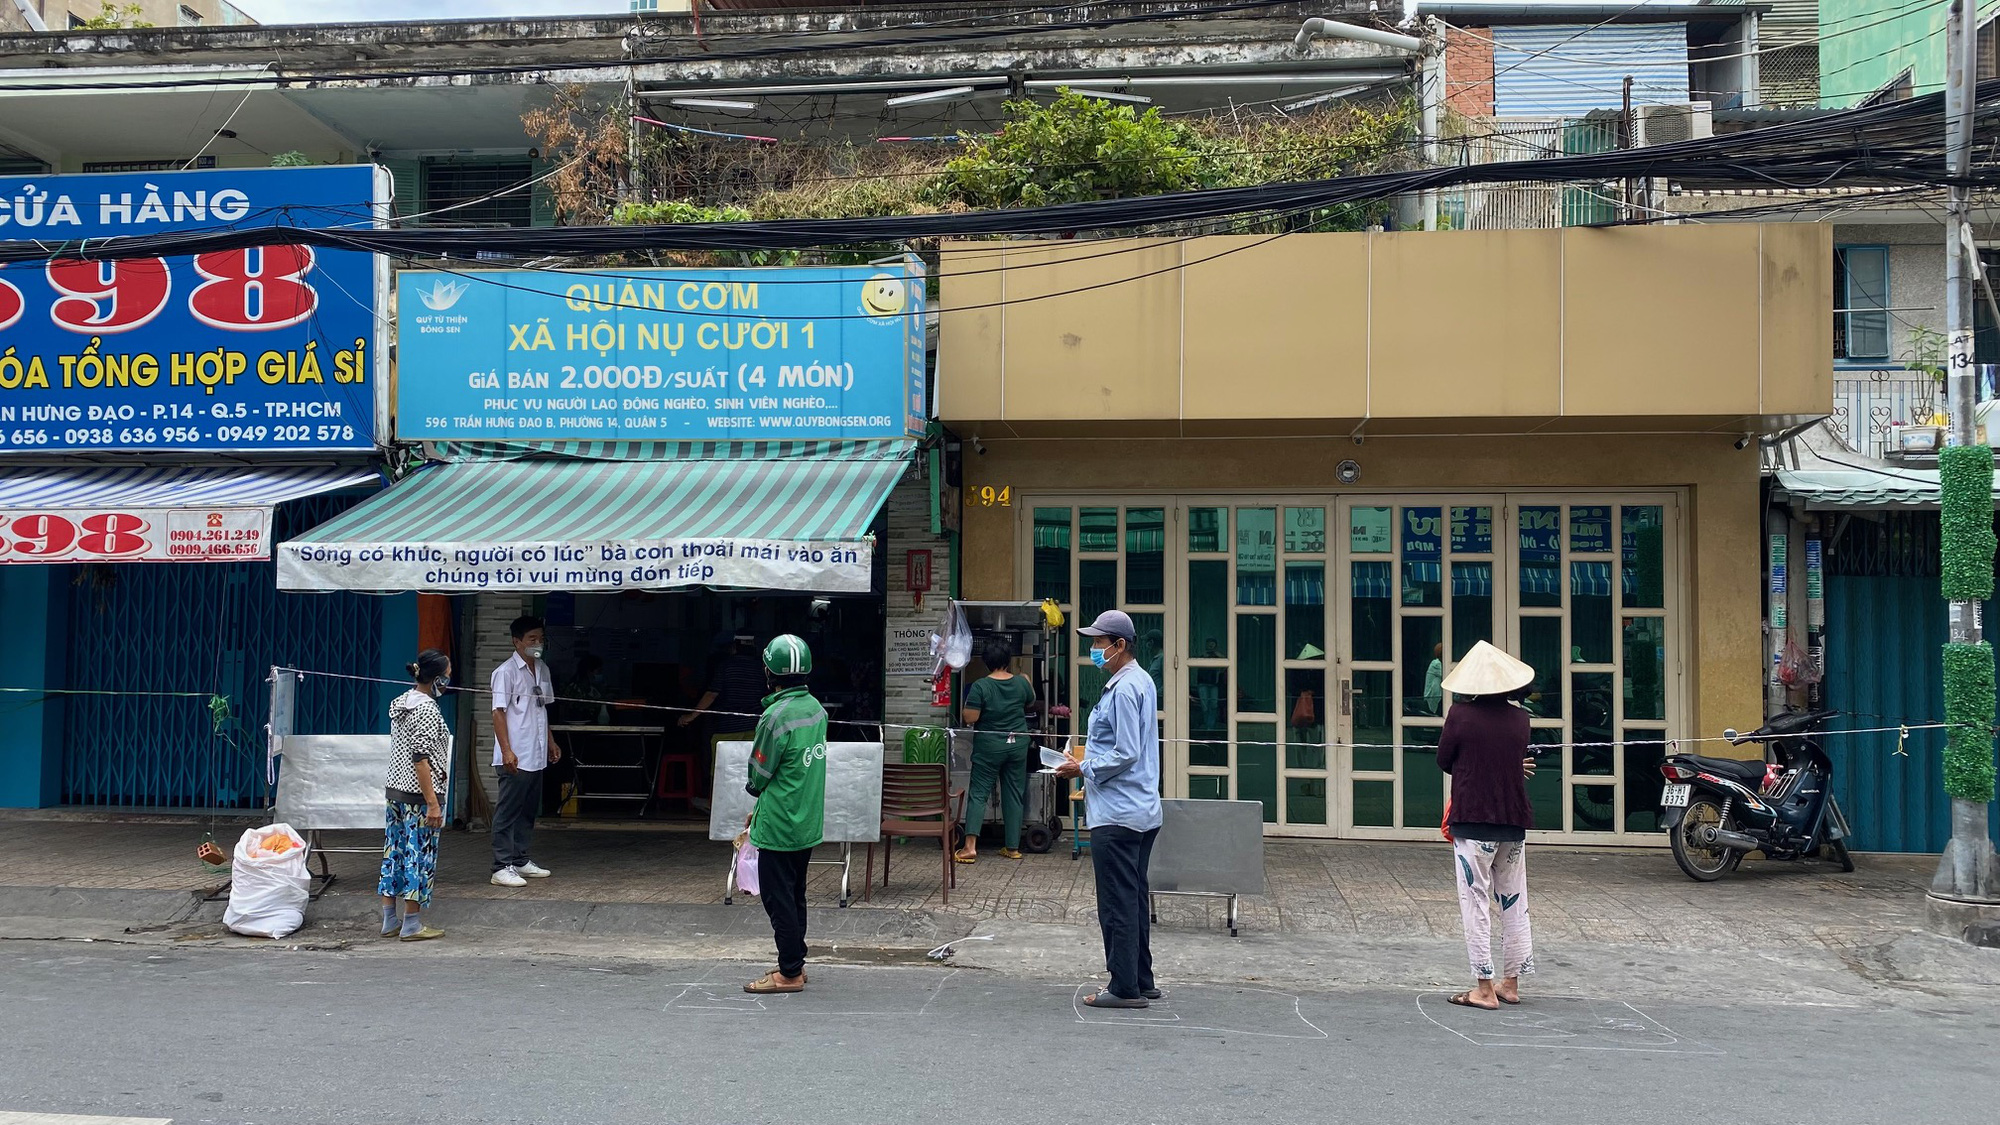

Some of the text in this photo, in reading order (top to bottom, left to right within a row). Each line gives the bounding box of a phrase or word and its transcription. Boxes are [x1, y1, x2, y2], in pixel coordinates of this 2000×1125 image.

[100, 183, 250, 224] HÀNG
[0, 243, 319, 336] 98
[565, 278, 758, 313] QUÁN CƠM
[421, 324, 444, 333] BÔNG
[508, 315, 815, 357] XÃ HỘI NỤ CƯỜI 1
[57, 336, 160, 388] TỔNG
[170, 346, 247, 395] HỢP
[257, 339, 324, 386] GIÁ
[334, 337, 366, 385] SỈ
[508, 369, 549, 389] BÁN
[560, 365, 729, 389] 2.000Đ/SUẤT
[738, 362, 766, 392] (4
[777, 360, 854, 392] MÓN)
[0, 406, 15, 421] N
[22, 404, 82, 421] HƯNG
[87, 404, 135, 425] ĐẠO
[153, 403, 193, 420] P.14
[211, 402, 247, 419] Q.5
[265, 402, 341, 418] TP.HCM
[484, 398, 518, 413] PHỤC
[523, 398, 542, 413] VỤ
[547, 396, 586, 410] NGƯỜI
[591, 398, 617, 410] LAO
[622, 396, 659, 413] ĐỘNG
[714, 398, 744, 410] SINH
[749, 395, 778, 410] VIÊN
[425, 417, 447, 428] 596
[453, 414, 482, 428] TRẦN
[485, 416, 515, 428] HƯNG
[518, 417, 542, 430] ĐẠO
[560, 415, 603, 428] PHƯỜNG
[625, 414, 655, 430] QUẬN
[660, 417, 667, 428] 5
[707, 416, 755, 428] WEBSITE:
[759, 415, 891, 428] WWW.QUYBONGSEN.ORG
[11, 429, 48, 444] 656
[65, 428, 114, 444] 0938
[119, 427, 157, 443] 636
[162, 427, 200, 442] 956
[217, 426, 267, 441] 0949
[273, 425, 310, 441] 202
[317, 425, 354, 441] 578
[965, 485, 1011, 507] 594
[0, 513, 153, 559] 98
[170, 529, 260, 542] 0904.261.249
[169, 543, 258, 555] 0909.466.656
[359, 545, 384, 562] có
[392, 545, 448, 564] khúc,
[455, 545, 514, 565] người
[521, 545, 546, 562] có
[601, 544, 626, 561] bà
[635, 546, 673, 560] con
[681, 540, 733, 558] thoải
[740, 543, 780, 560] mái
[788, 546, 823, 562] vào
[830, 546, 857, 563] ăn
[425, 559, 714, 586] chúng tôi vui mừng đón tiếp
[893, 629, 925, 638] THÔNG
